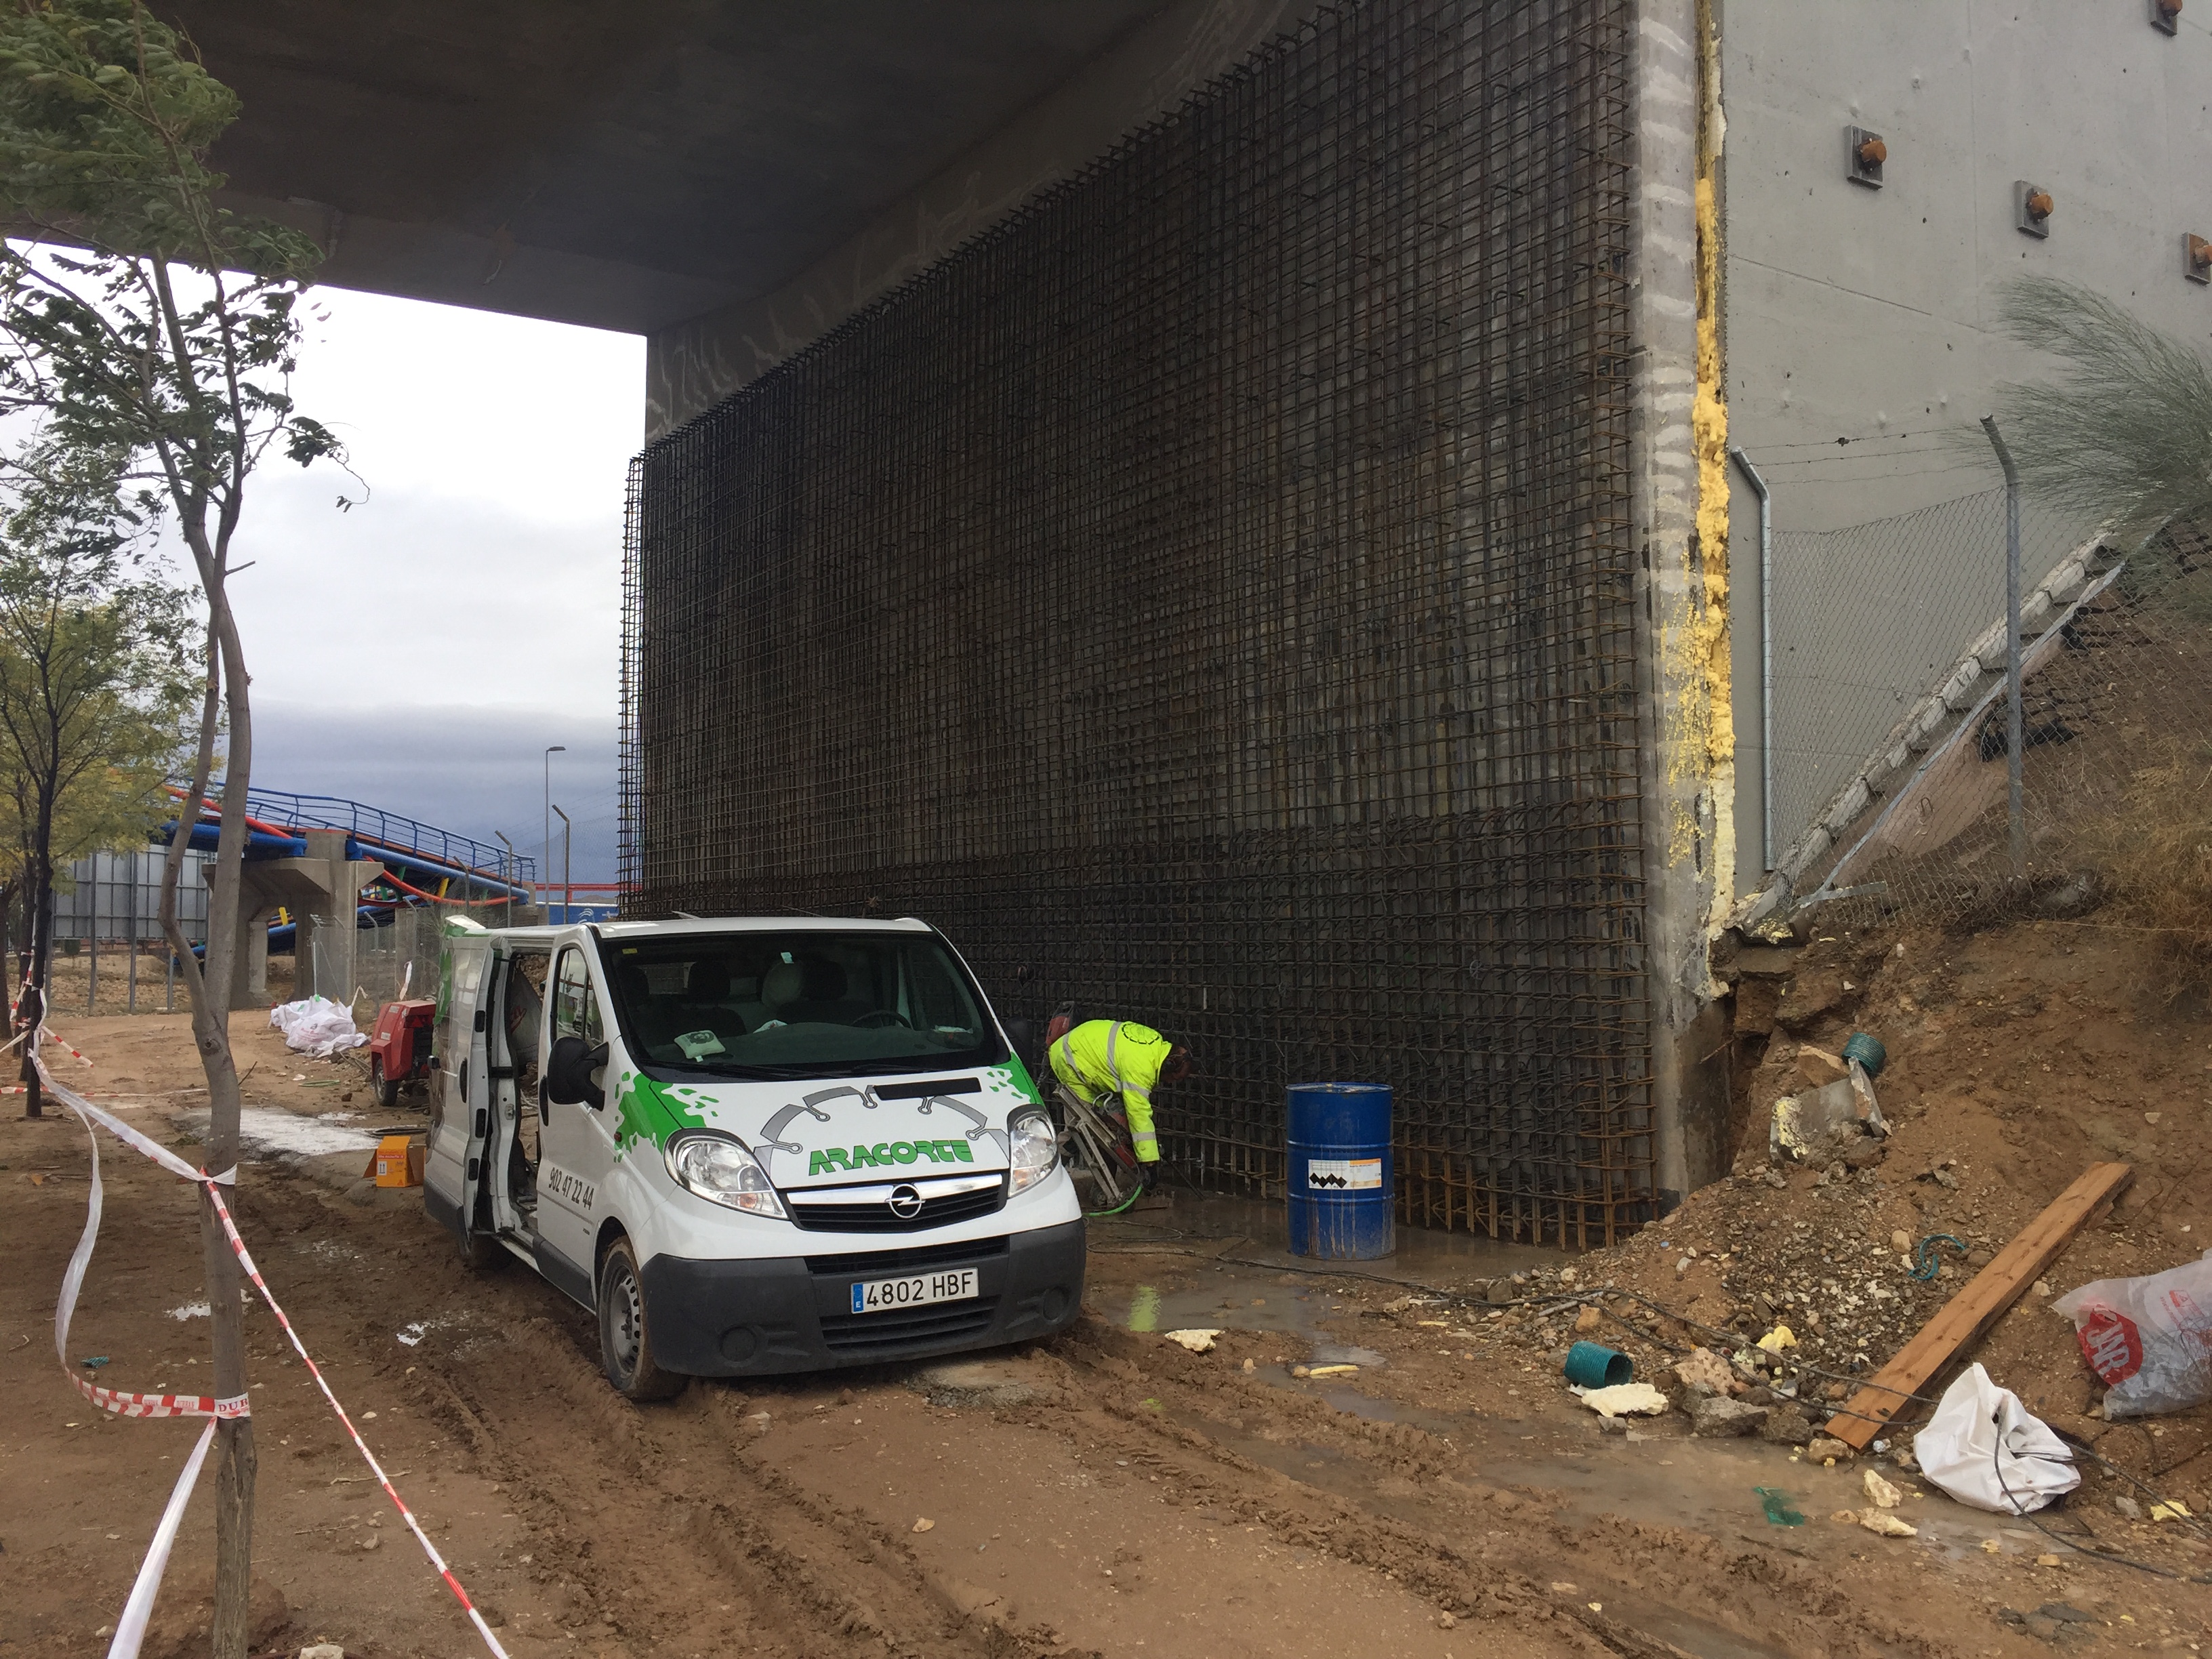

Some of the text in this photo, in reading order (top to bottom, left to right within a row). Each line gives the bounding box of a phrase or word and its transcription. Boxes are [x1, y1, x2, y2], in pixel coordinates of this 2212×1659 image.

[808, 1140, 975, 1176] ARACORTE
[548, 1167, 594, 1210] 902 47 22 44
[855, 1300, 861, 1309] E
[866, 1271, 973, 1307] 4802 HBF
